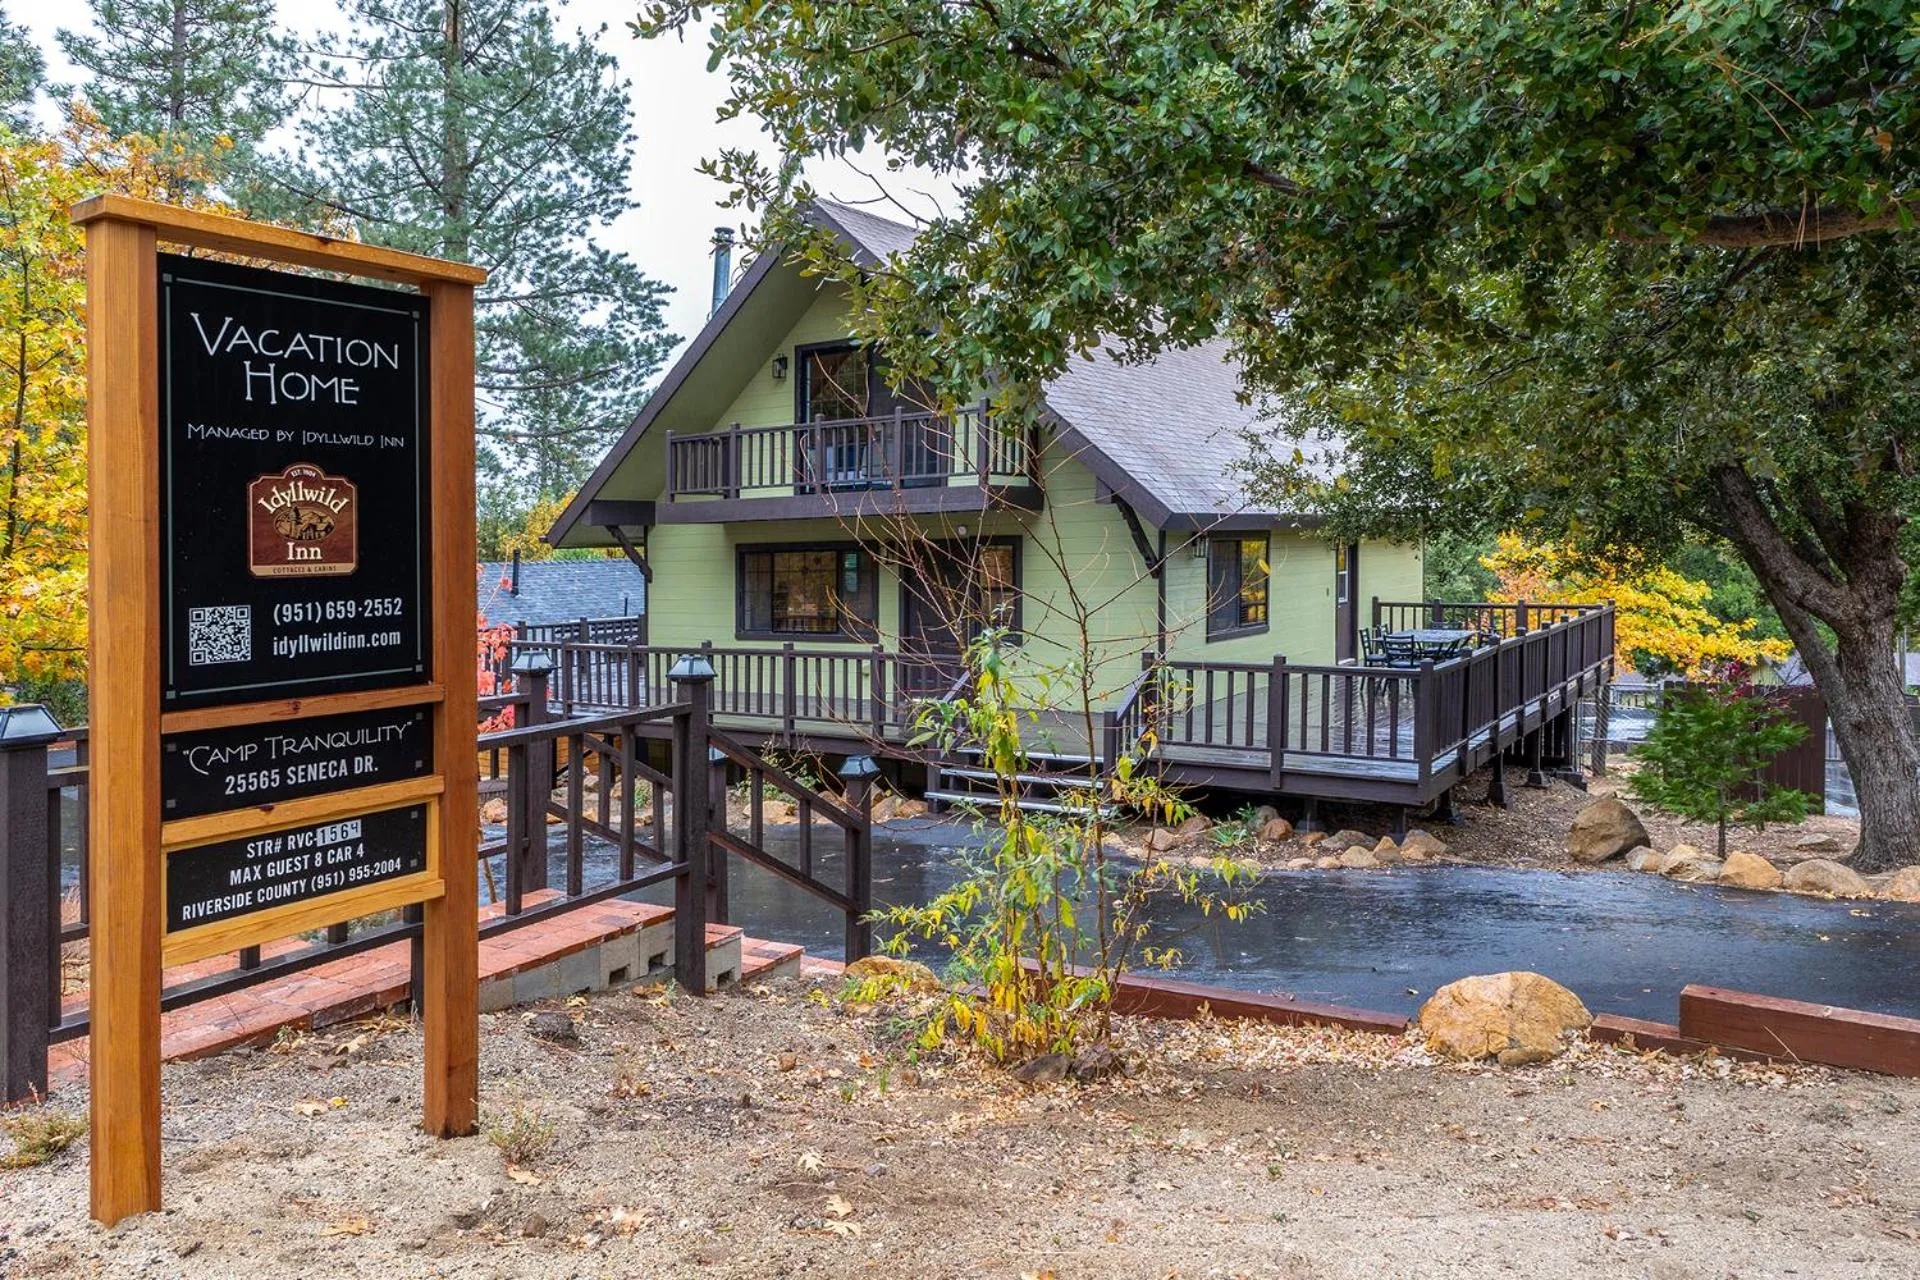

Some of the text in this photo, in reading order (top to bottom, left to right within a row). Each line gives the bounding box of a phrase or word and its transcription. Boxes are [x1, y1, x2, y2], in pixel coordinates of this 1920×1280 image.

[190, 312, 399, 369] VACATION
[243, 360, 359, 404] HOME
[187, 423, 404, 448] MANAGED BY IDYLLWILD INN
[258, 480, 350, 515] Idyllwild
[287, 541, 323, 561] Inn
[273, 601, 322, 626] (951)
[273, 631, 401, 658] idyllwildinn.com
[225, 755, 378, 795] 25565 SENECA DR.
[229, 842, 364, 886] MAX GUEST 8 CAR 4
[246, 837, 282, 859] STR#
[182, 857, 401, 921] RIVERSIDE COUNTY (951) 955-2004
